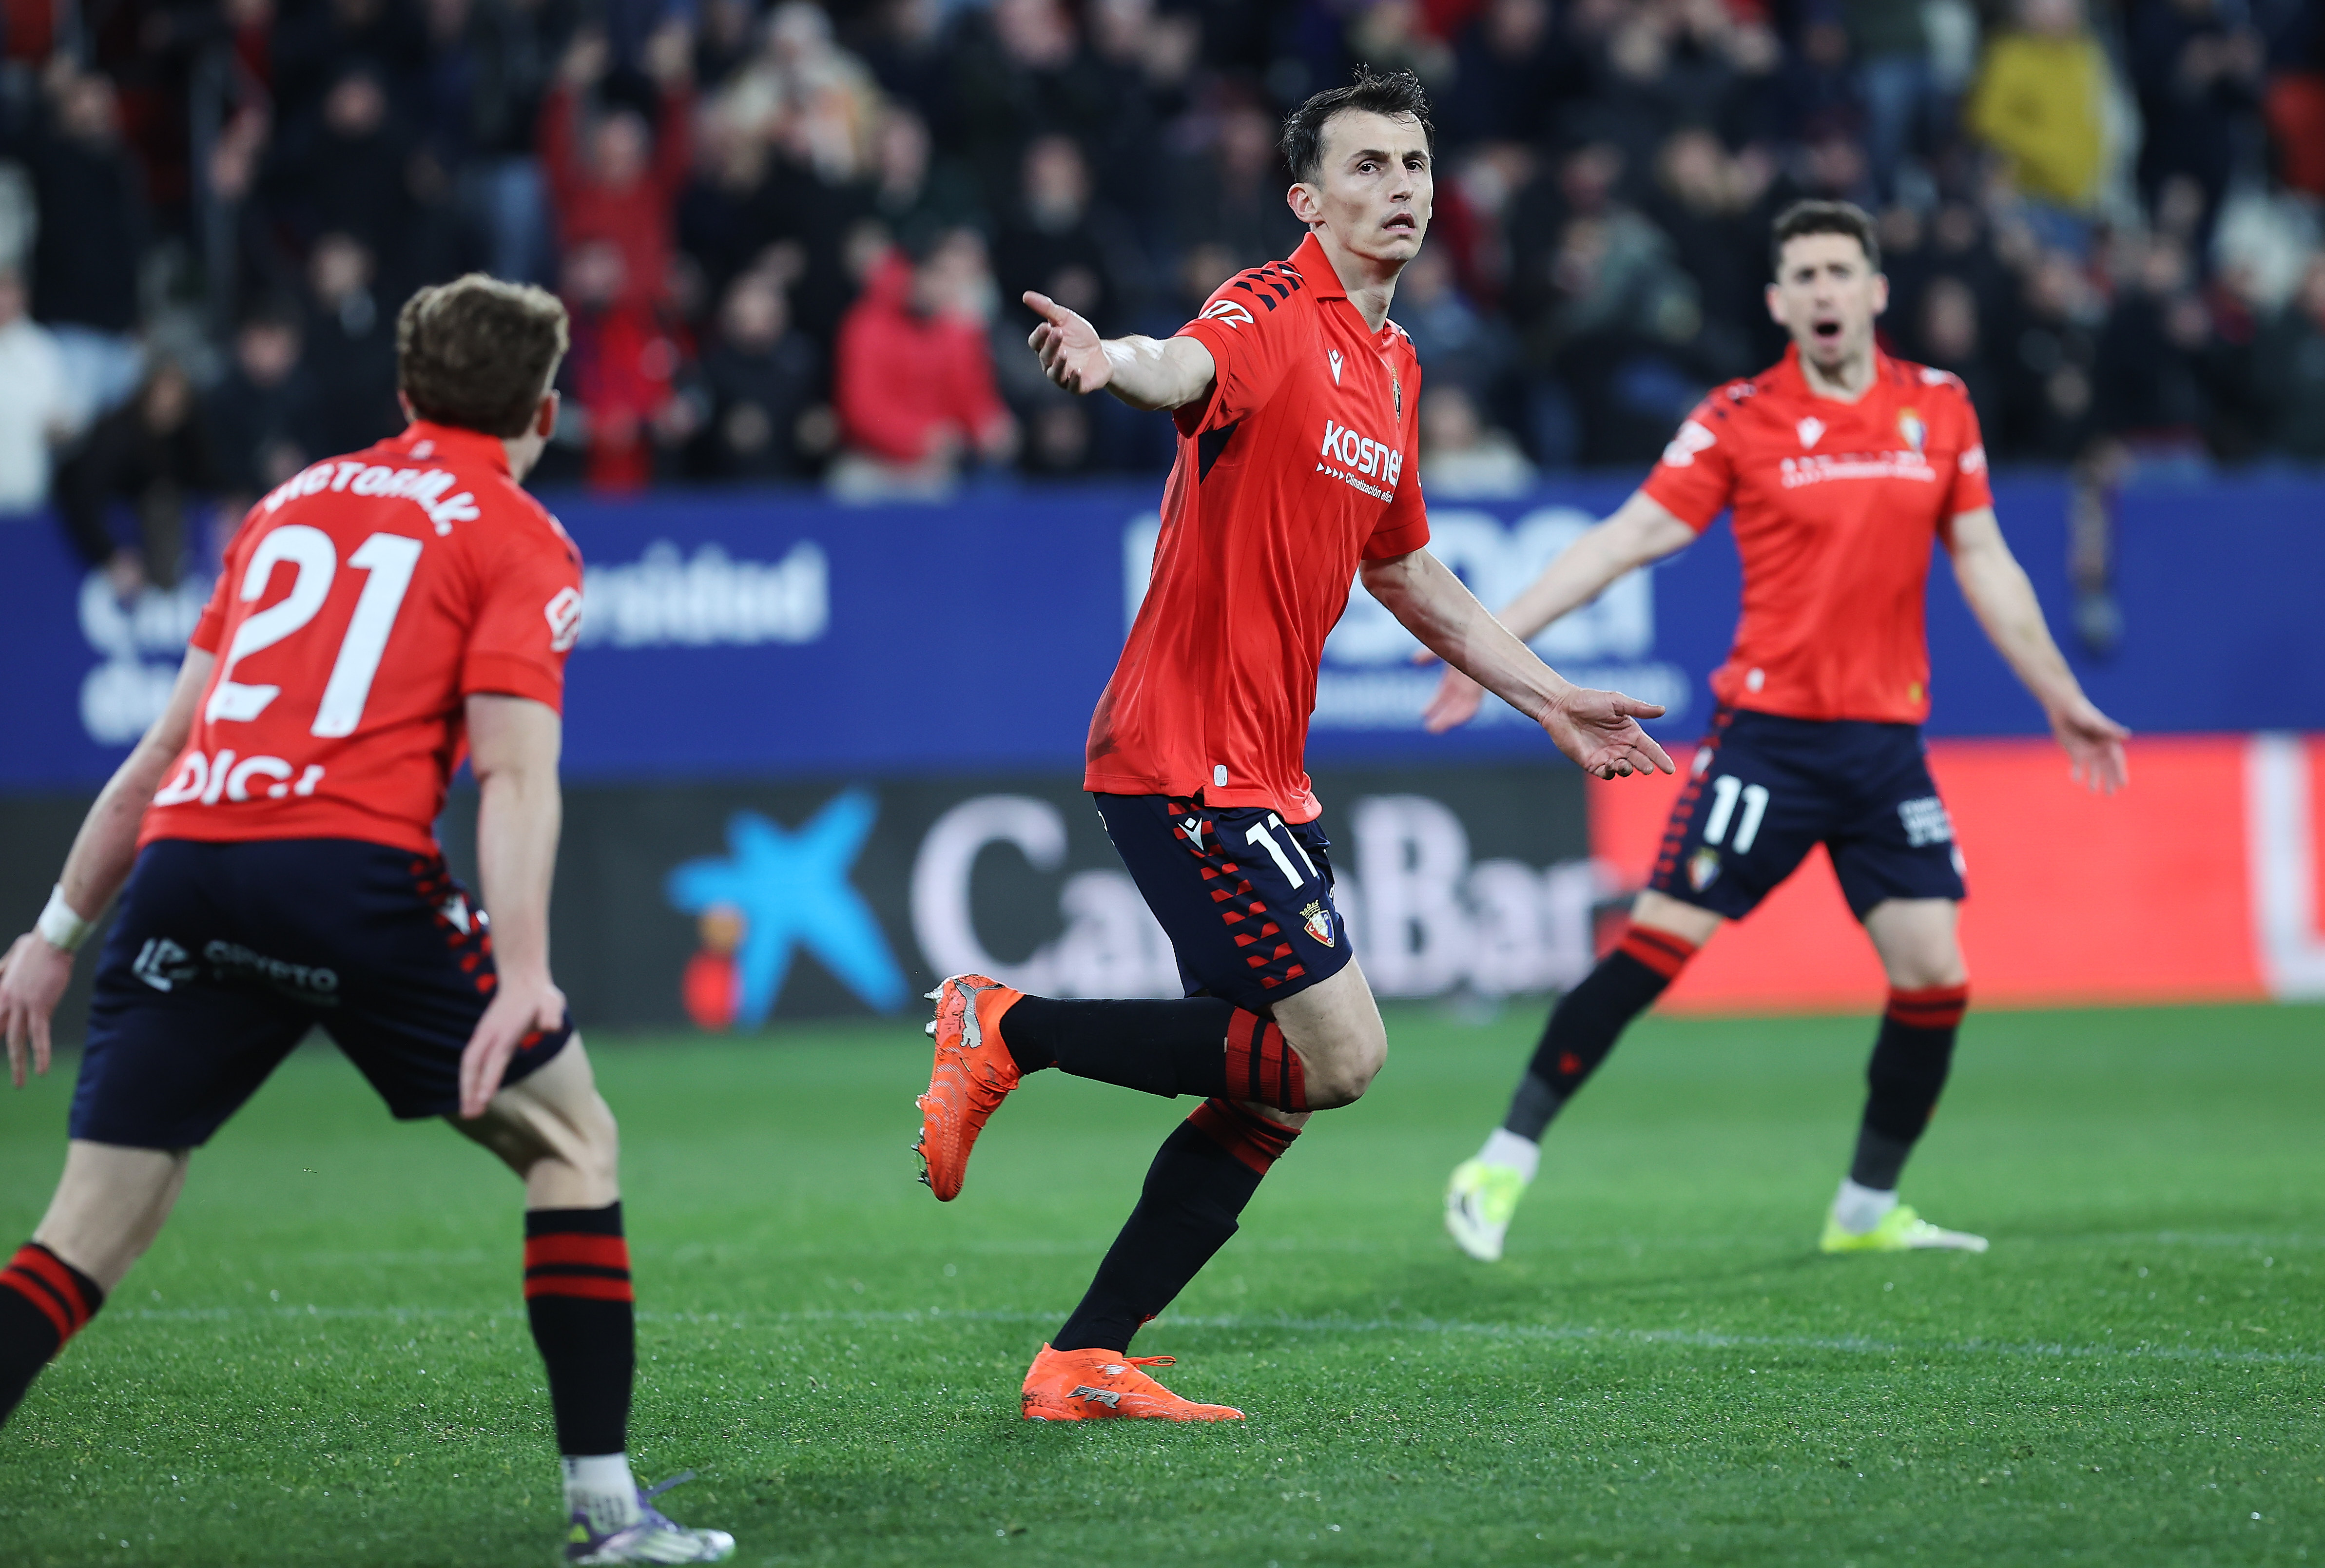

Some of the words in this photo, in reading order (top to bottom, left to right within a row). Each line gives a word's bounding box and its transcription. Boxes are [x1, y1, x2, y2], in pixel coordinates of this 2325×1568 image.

[1345, 471, 1381, 499] Climatización
[205, 524, 424, 738] 21
[1702, 774, 1770, 856] 11
